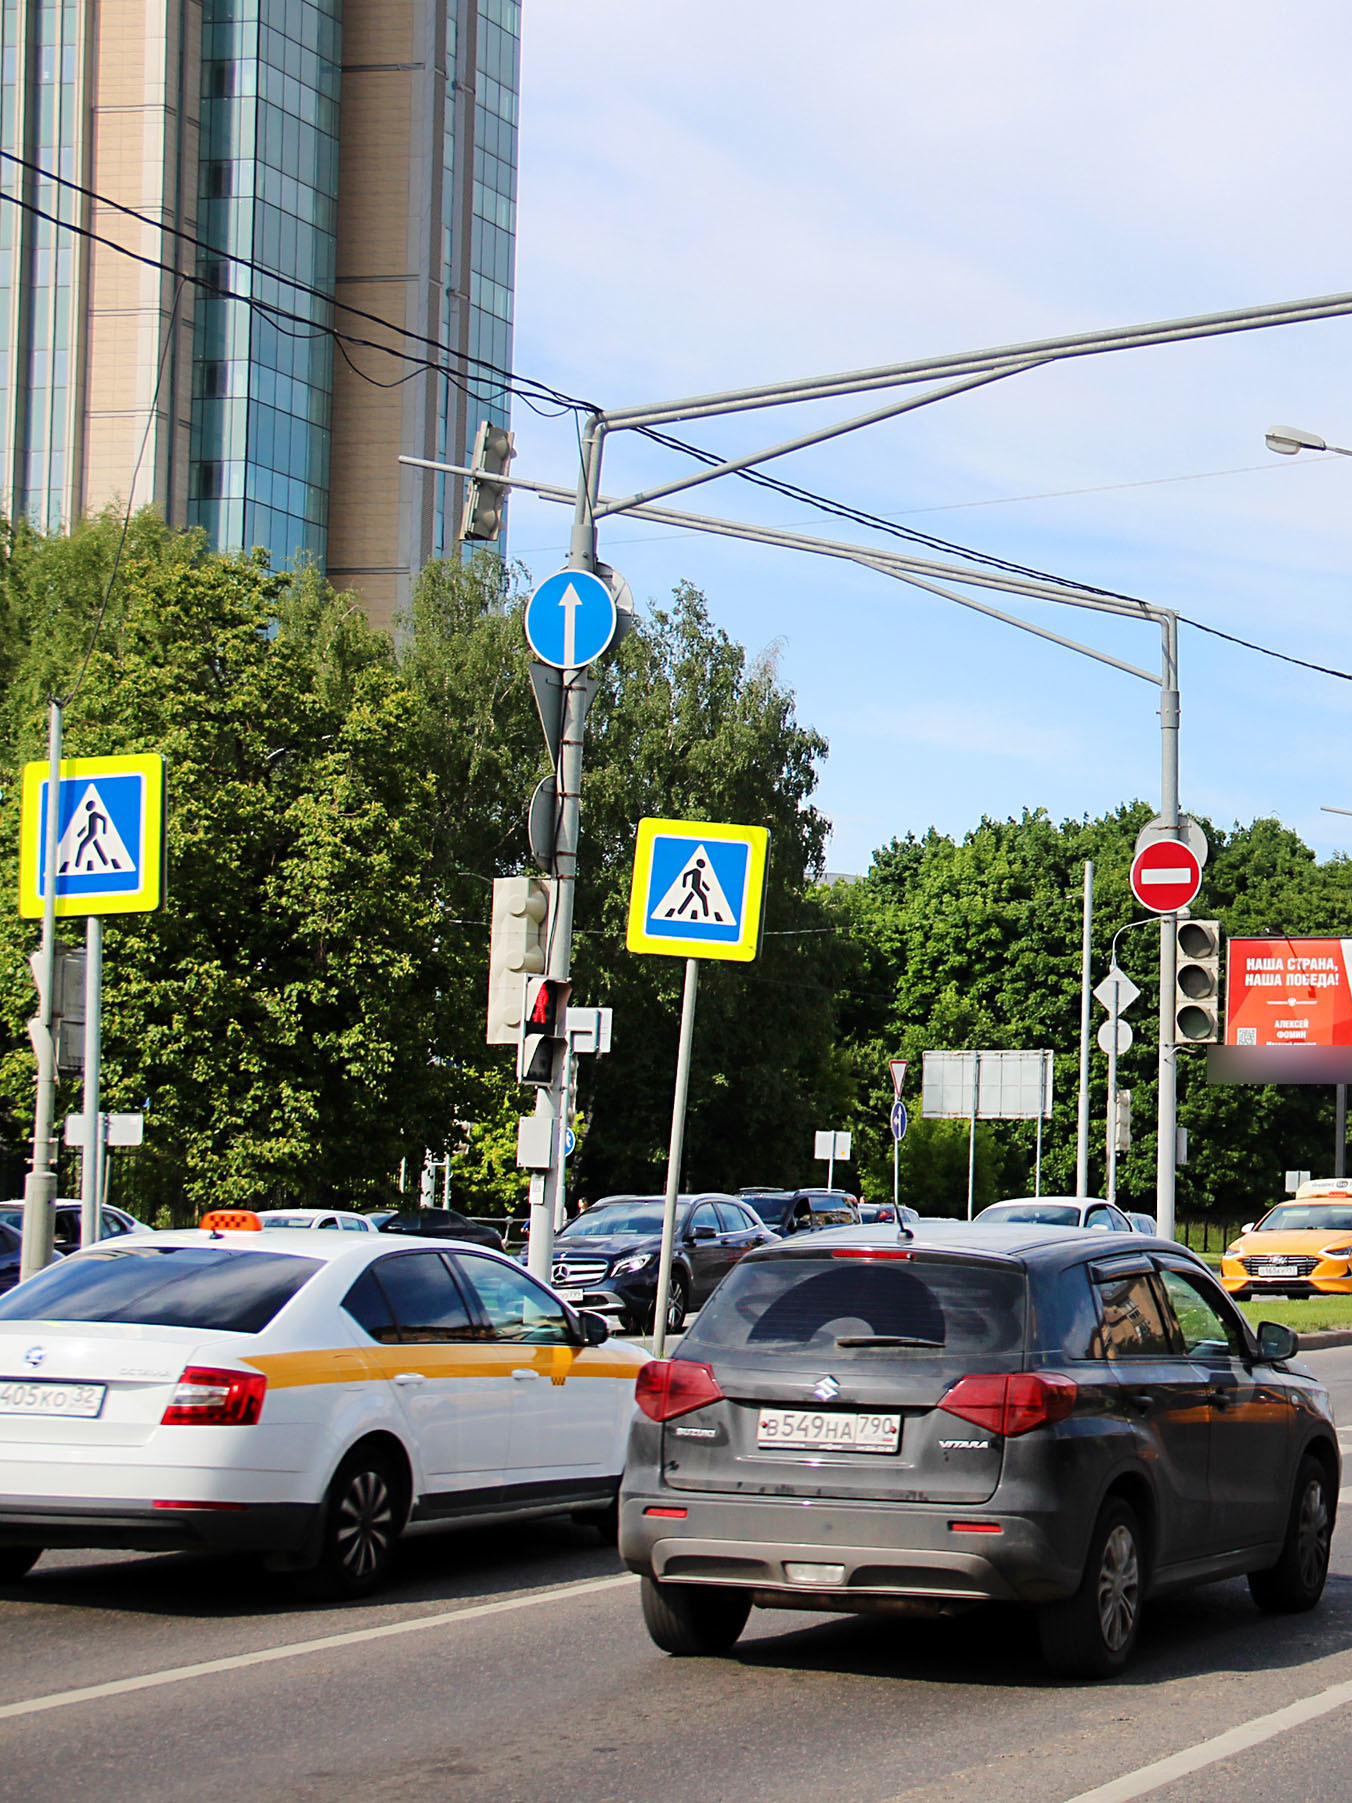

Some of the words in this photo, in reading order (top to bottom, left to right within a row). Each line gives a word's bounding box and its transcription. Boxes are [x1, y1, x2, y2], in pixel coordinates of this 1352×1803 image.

[1246, 958, 1284, 971] НАША
[1287, 958, 1338, 972] СТРАНА,
[1245, 973, 1282, 986] НАША
[1286, 973, 1339, 988] ПОБЕДА!
[1274, 1018, 1309, 1028] АЛЕКСЕЙ
[1277, 1030, 1306, 1039] ФОМИН
[73, 1386, 96, 1403] 32
[859, 1416, 893, 1435] 790
[938, 1440, 989, 1449] VITARA
